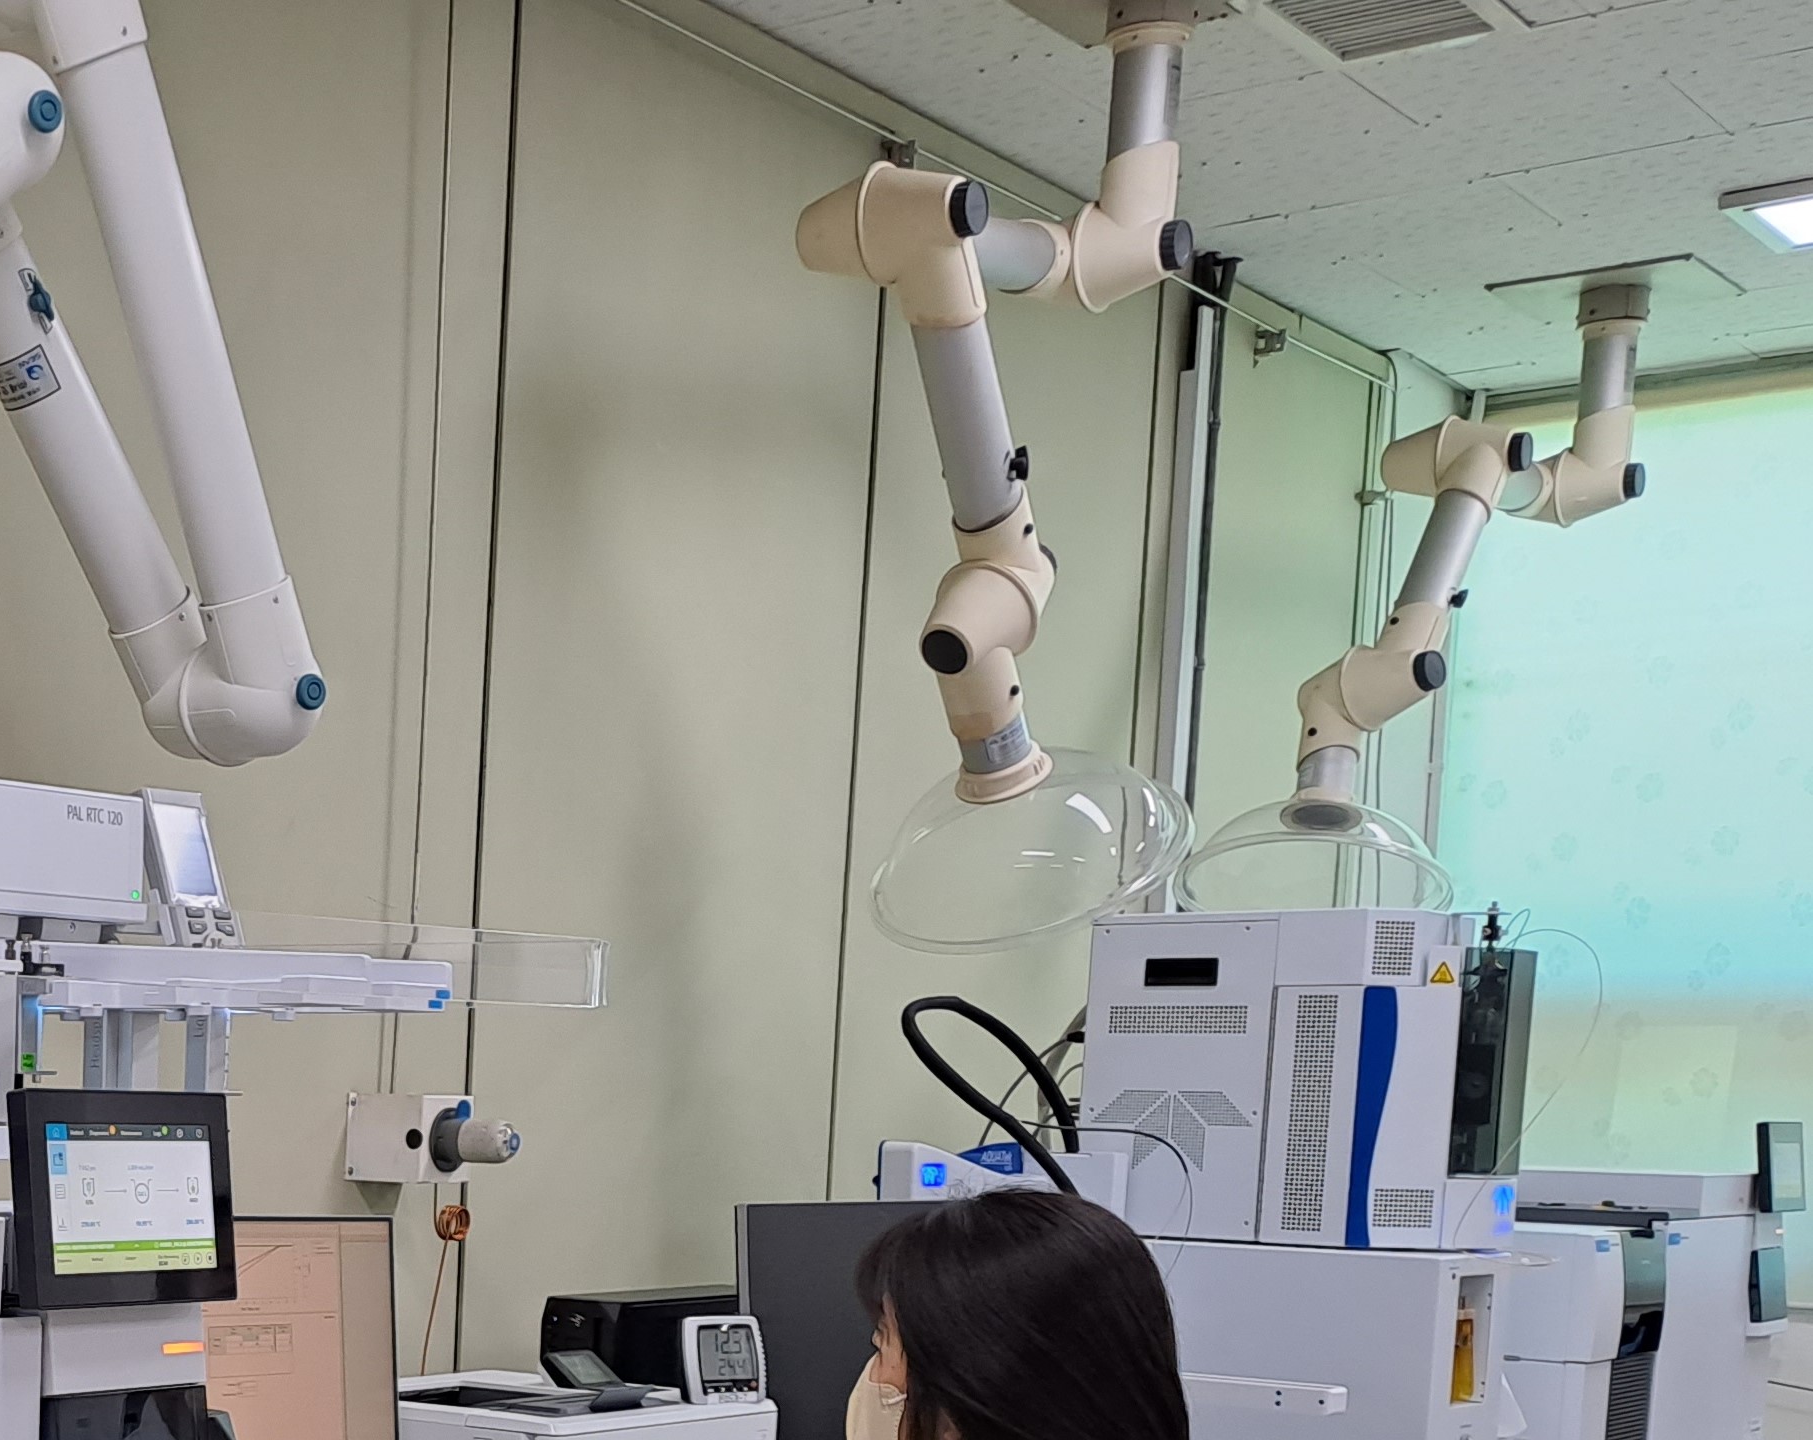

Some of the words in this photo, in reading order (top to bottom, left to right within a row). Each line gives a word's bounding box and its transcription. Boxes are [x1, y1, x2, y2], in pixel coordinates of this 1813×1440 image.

[67, 804, 84, 822] PAL
[87, 806, 105, 825] RTC
[107, 810, 124, 827] 120
